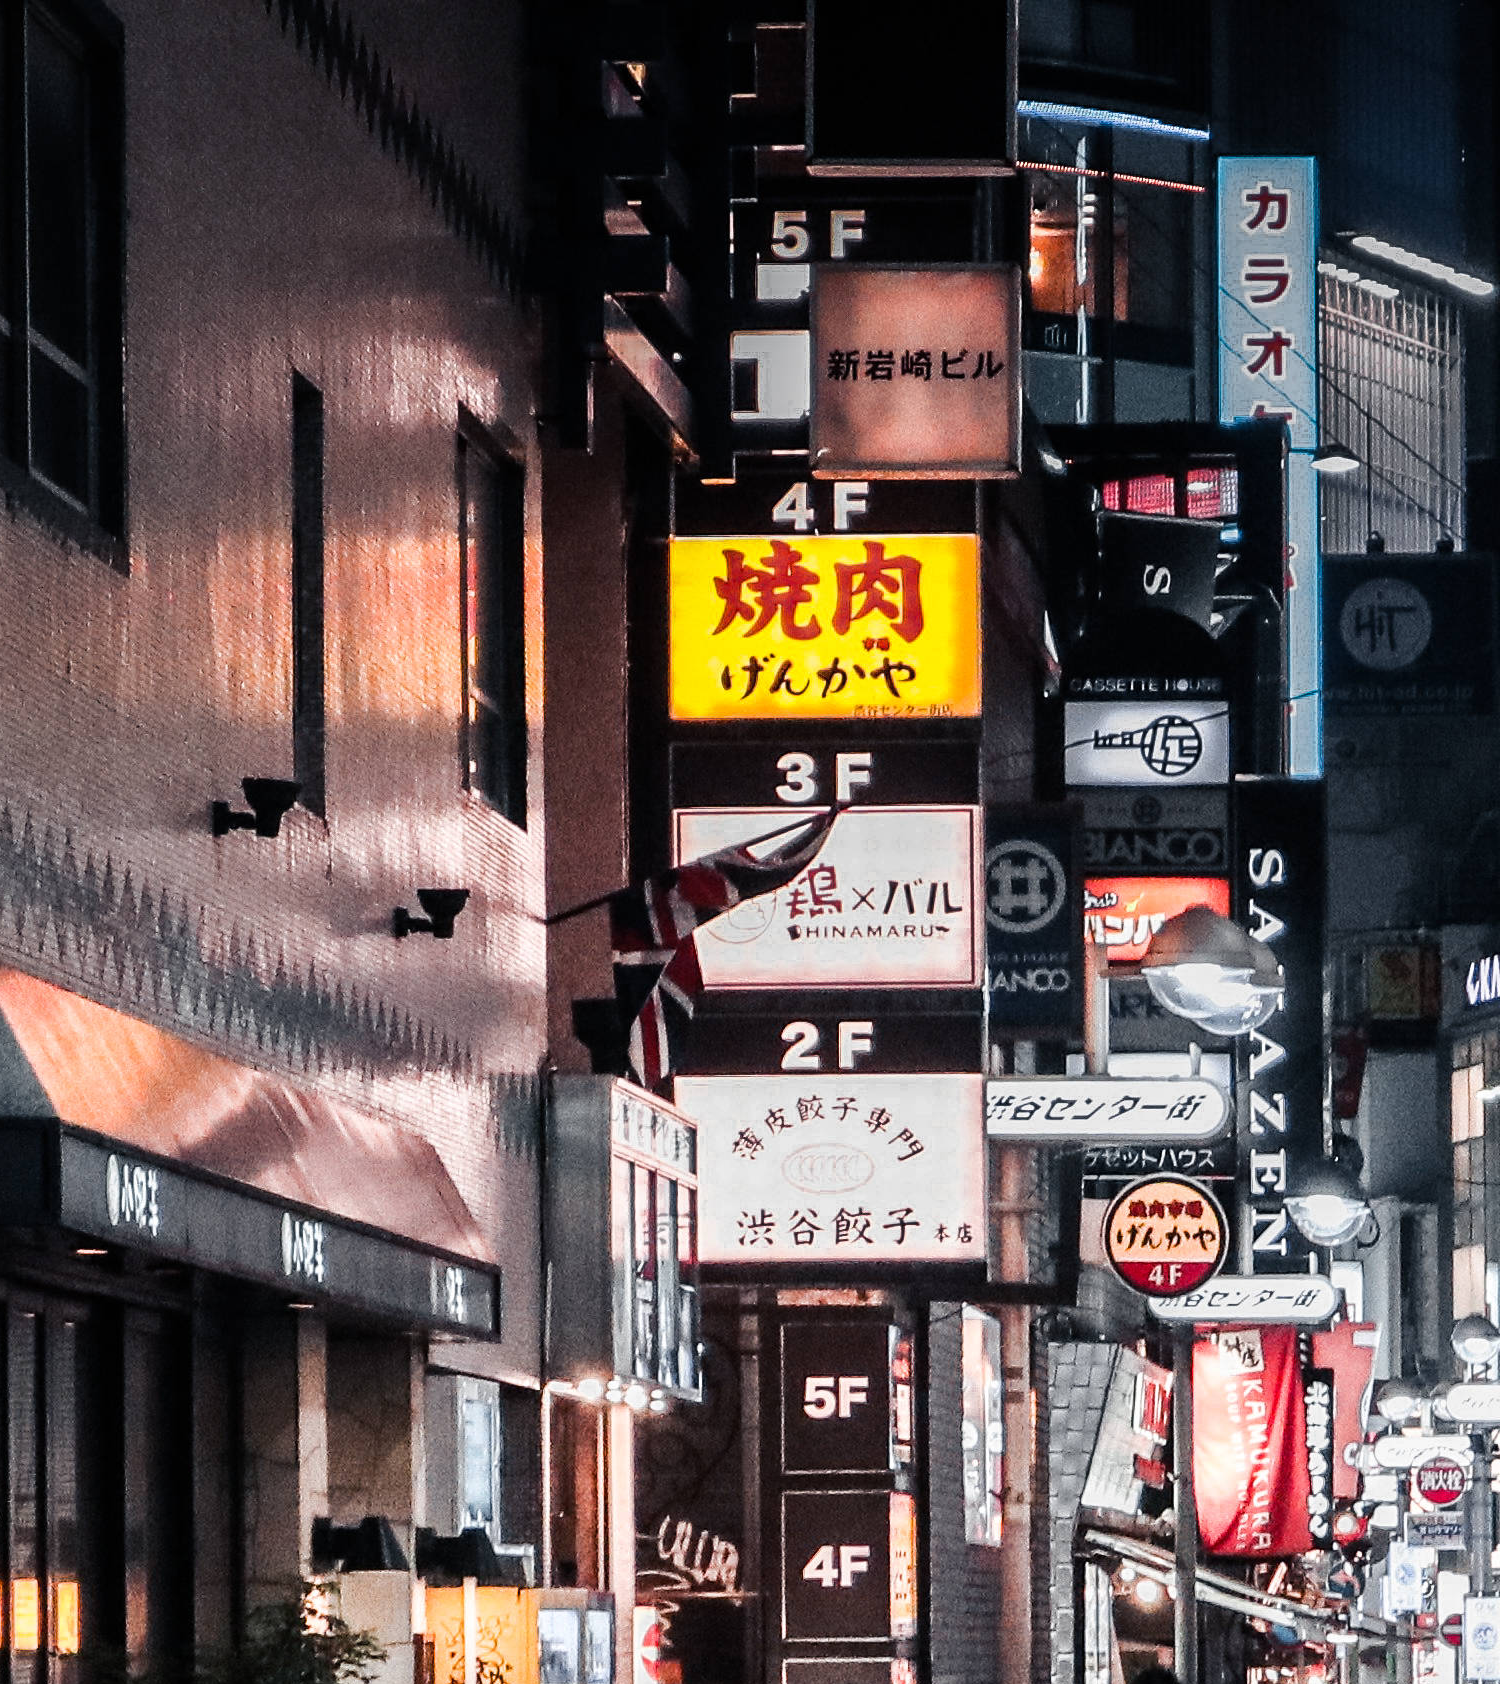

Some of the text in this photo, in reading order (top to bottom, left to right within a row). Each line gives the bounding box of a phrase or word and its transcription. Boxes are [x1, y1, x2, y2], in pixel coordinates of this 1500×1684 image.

[769, 209, 867, 260] 5F
[827, 350, 1007, 382] 新岩崎ビル
[771, 481, 871, 530] 4F
[712, 540, 924, 642] 焼肉
[721, 653, 917, 700] げんかや
[774, 752, 874, 801] 3F
[779, 1021, 874, 1070] 2F
[736, 1206, 973, 1247] 渋谷餃子 本店
[1116, 1225, 1217, 1251] げんかや
[1148, 1264, 1183, 1287] 4F
[803, 1376, 870, 1420] 5F
[1242, 1378, 1272, 1551] KAMUKURA
[1420, 1470, 1463, 1492] 消火栓
[802, 1545, 871, 1589] 4F
